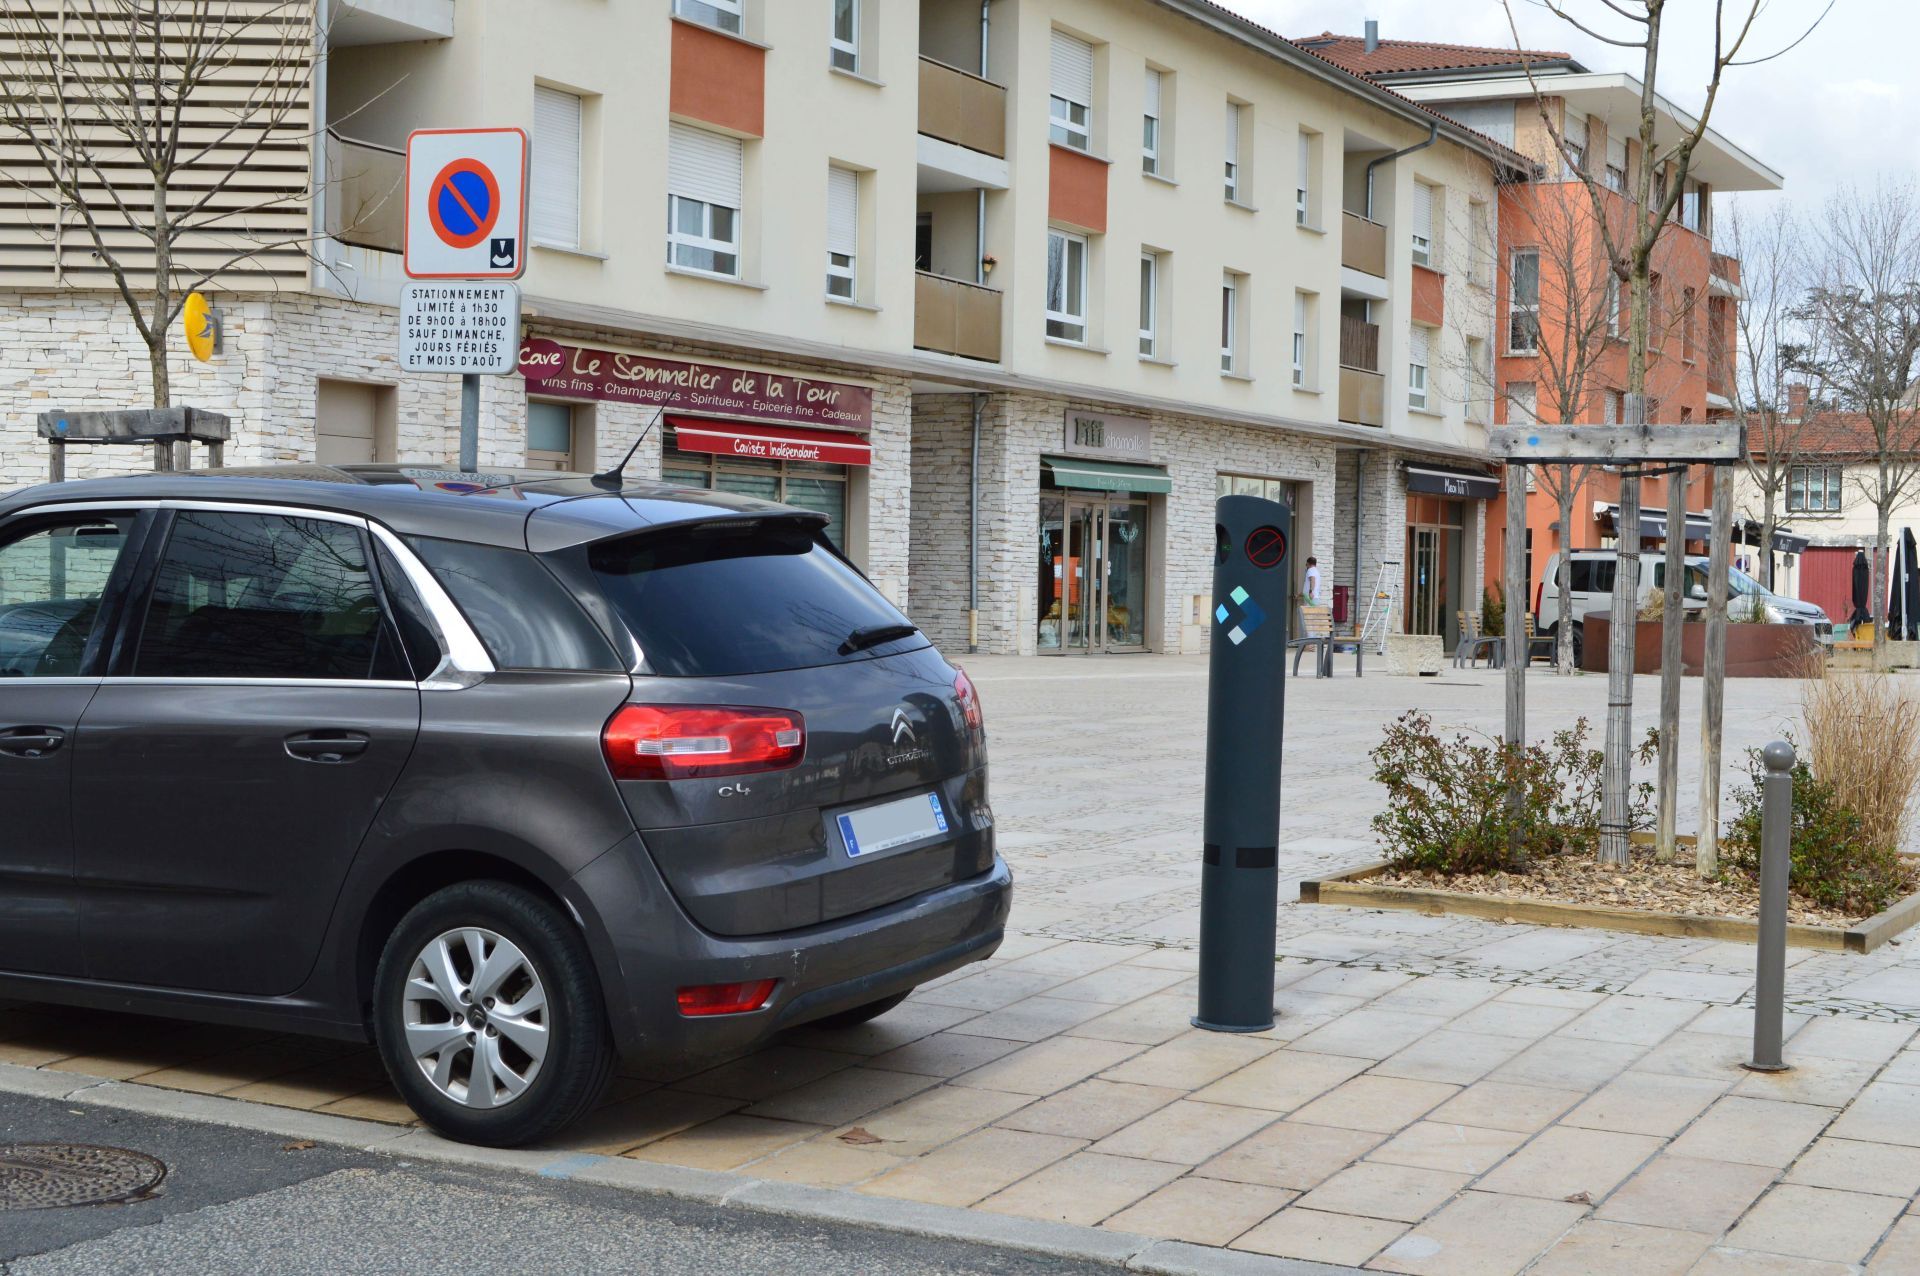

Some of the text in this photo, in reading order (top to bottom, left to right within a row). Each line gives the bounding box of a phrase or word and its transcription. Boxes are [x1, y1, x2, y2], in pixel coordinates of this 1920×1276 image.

[412, 289, 505, 300] STATIONNEMENT
[417, 301, 498, 313] LIMITÉ à 1h30
[408, 316, 506, 326] DE 9h00 à 18h00
[408, 329, 505, 342] SAUF DIMANCHE,
[415, 341, 497, 353] JOURS FÉRIÉS
[410, 355, 502, 366] ET MOIS D'AOÛT
[518, 346, 562, 366] Cave
[572, 348, 841, 405] Le Sommelier de la Tour
[570, 378, 594, 392] fins
[604, 382, 681, 401] Champagnes
[690, 392, 744, 409] Spiritueux
[752, 402, 793, 414] Epicerie
[795, 406, 814, 416] fine
[822, 408, 862, 422] Cadeaux
[734, 438, 820, 460] Caviste Indépendant
[718, 782, 751, 799] C4
